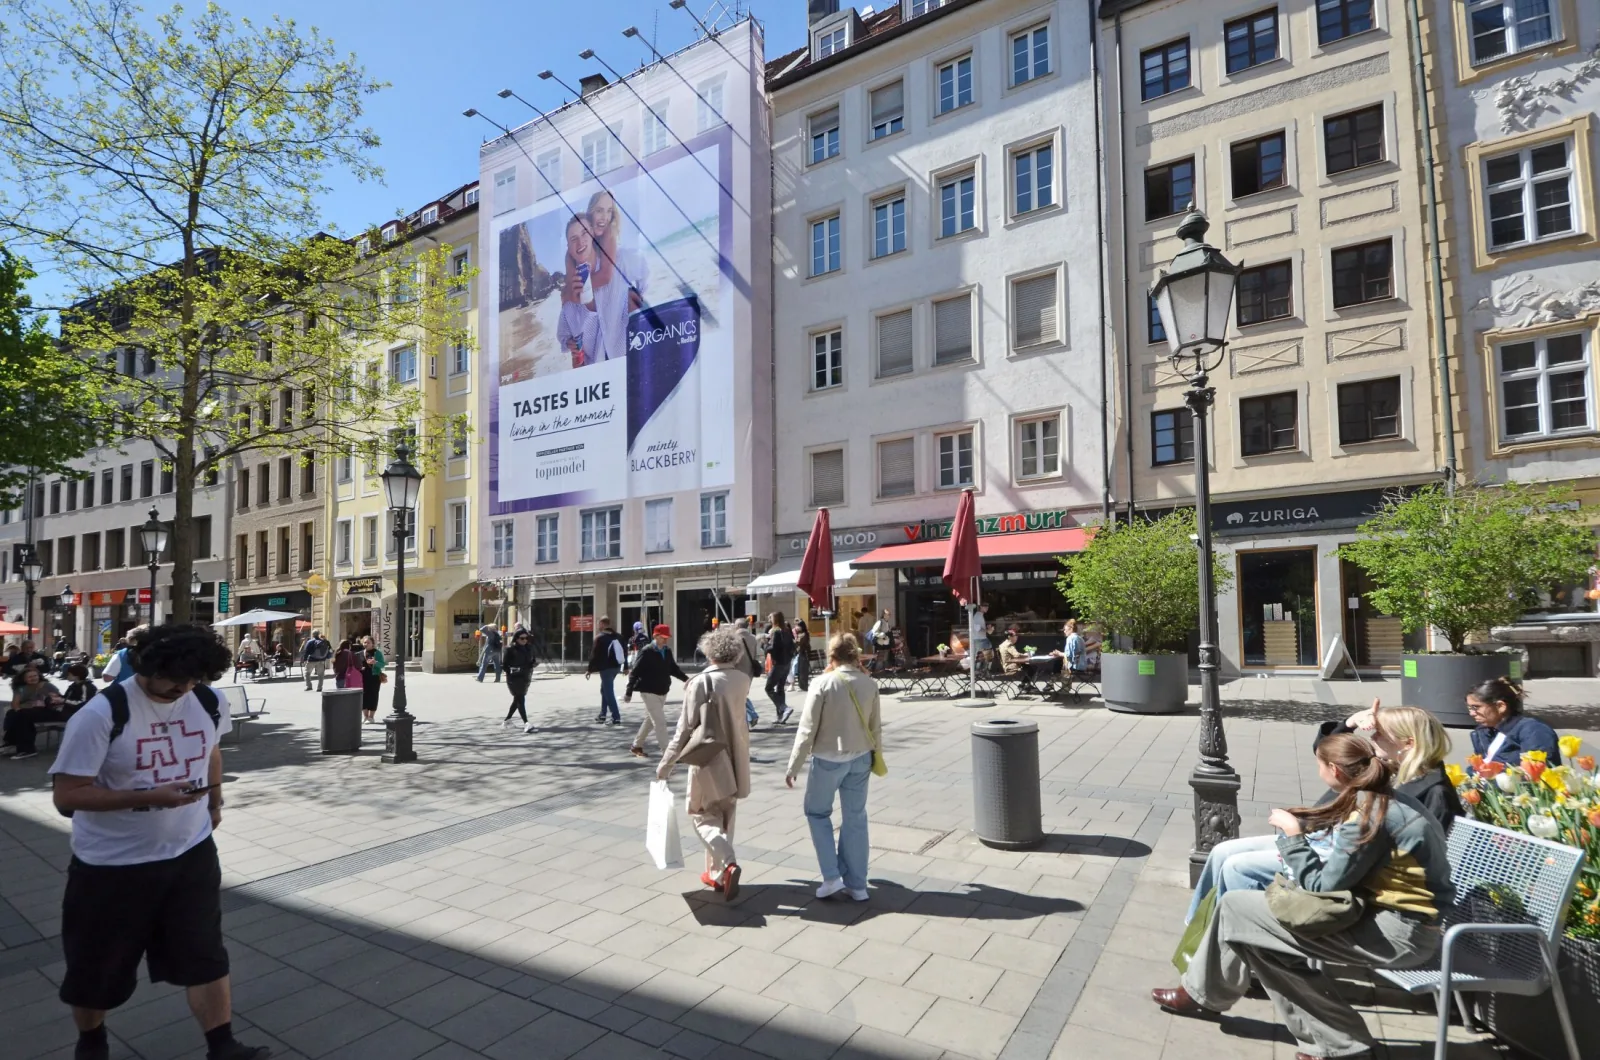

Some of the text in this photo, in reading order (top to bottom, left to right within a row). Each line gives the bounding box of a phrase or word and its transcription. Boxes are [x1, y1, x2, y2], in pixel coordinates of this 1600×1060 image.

[634, 320, 697, 350] ORGANICS
[514, 381, 610, 418] TASTES LIKE
[509, 404, 616, 440] living in the moment
[630, 449, 696, 472] BLACKBERRY
[646, 439, 678, 453] minty
[536, 459, 585, 480] topmodel
[903, 509, 1068, 540] vinznzmurr
[1248, 506, 1320, 523] ZURIGA
[220, 582, 229, 612] WEEKDAY
